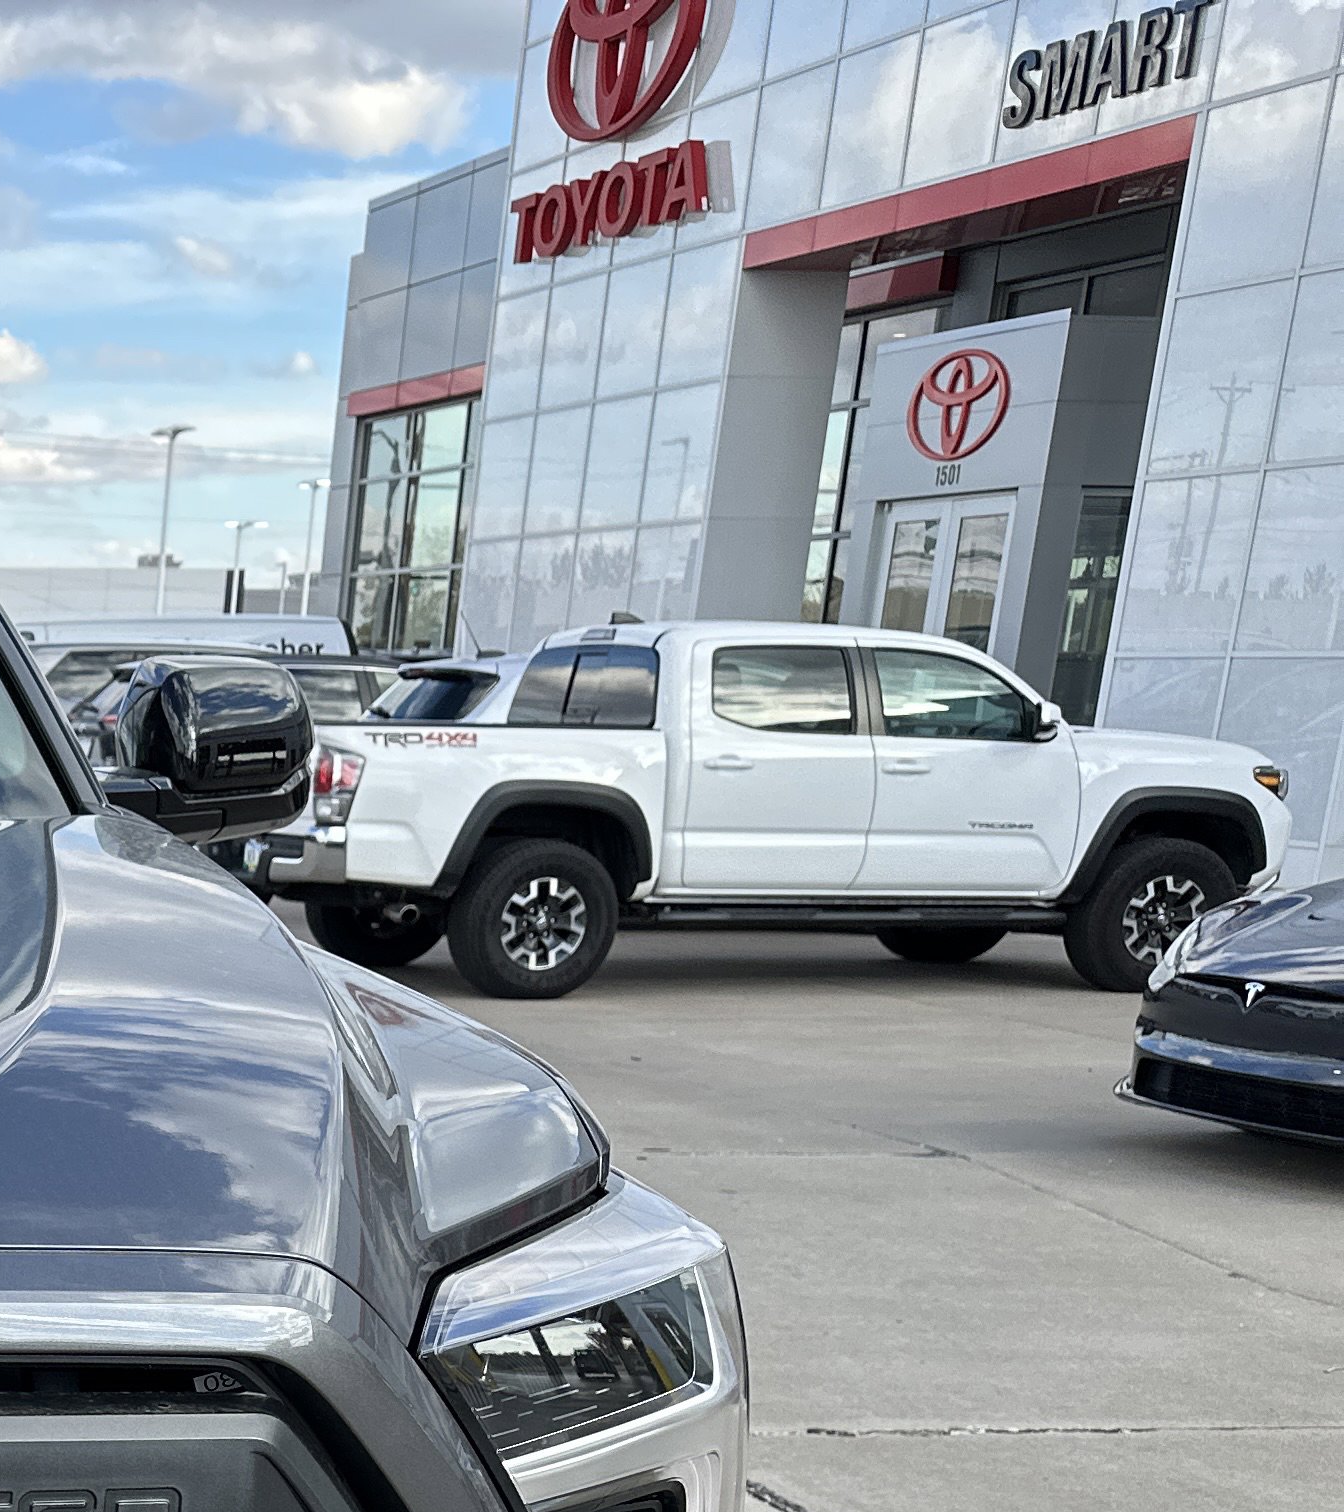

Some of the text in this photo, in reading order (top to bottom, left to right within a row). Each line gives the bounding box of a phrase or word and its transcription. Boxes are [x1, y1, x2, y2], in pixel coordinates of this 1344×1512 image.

[1002, 0, 1215, 129] SMART
[511, 140, 709, 264] TOYOTA
[935, 464, 962, 487] 1501
[364, 732, 423, 748] TRD
